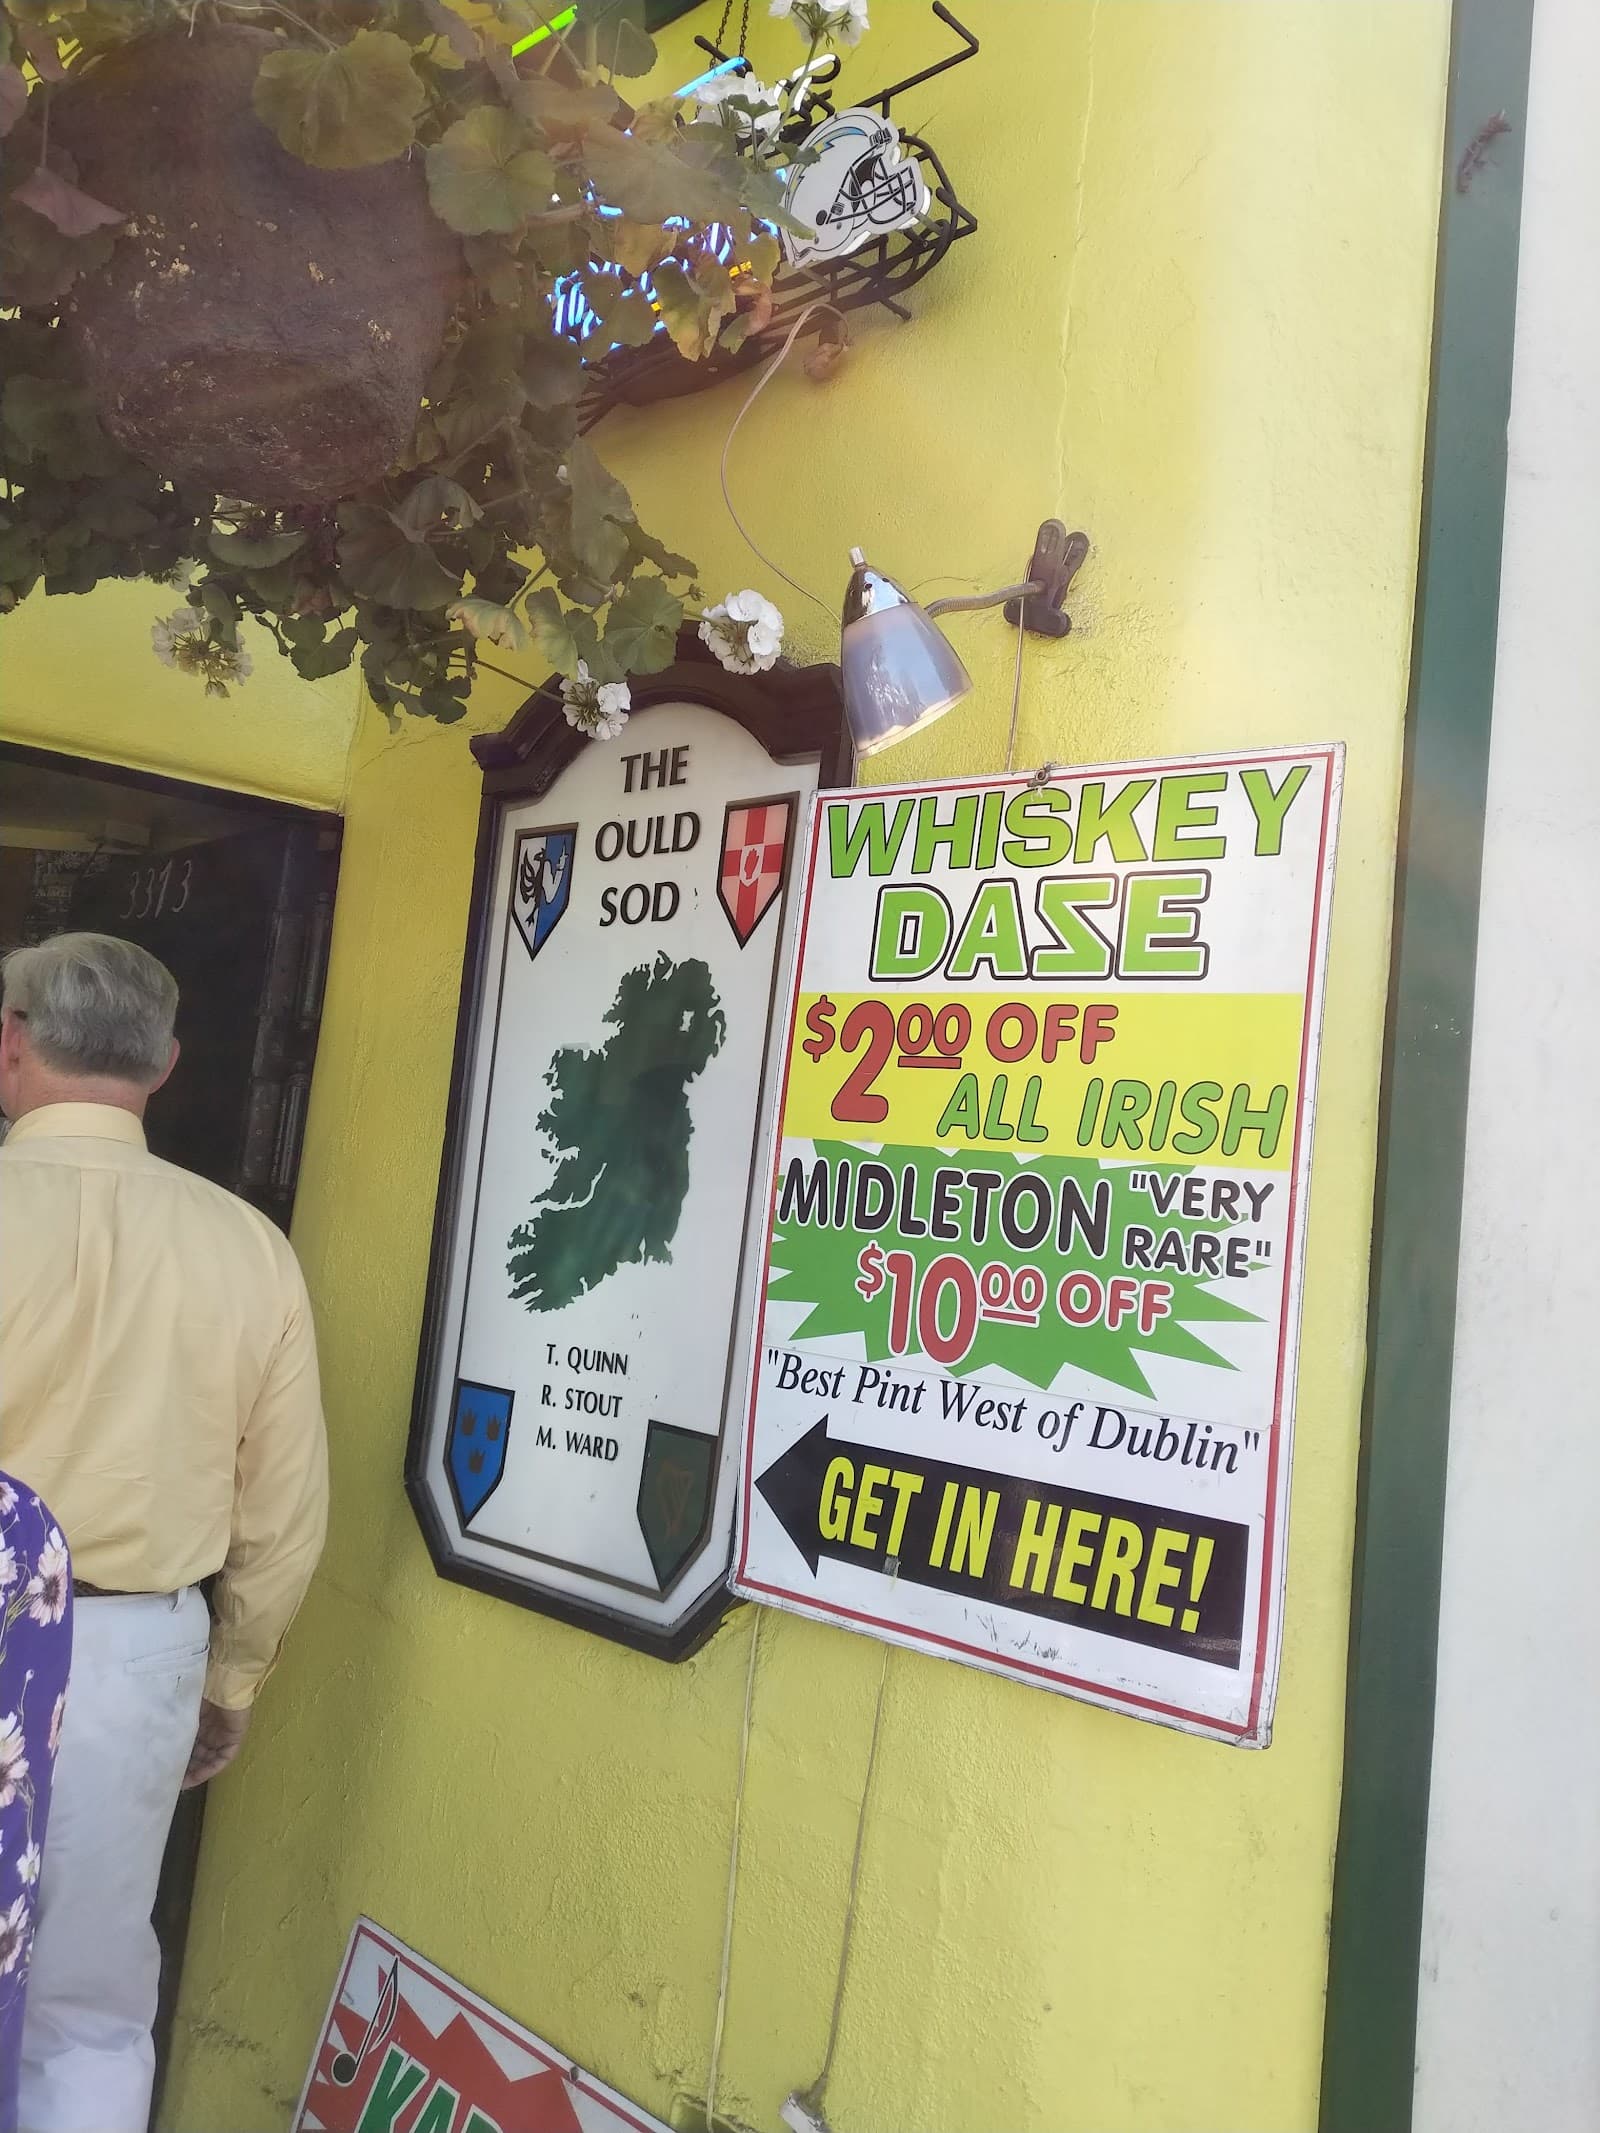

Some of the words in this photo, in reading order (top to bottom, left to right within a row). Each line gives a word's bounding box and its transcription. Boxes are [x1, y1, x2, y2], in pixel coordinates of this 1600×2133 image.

[620, 744, 690, 793] THE
[595, 811, 700, 861] OULD
[828, 765, 1312, 878] WHISKEY
[599, 881, 680, 927] SOD
[985, 1002, 1120, 1065] OFF
[936, 1073, 1049, 1144] ALL
[1077, 1077, 1289, 1159] IRISH
[778, 1157, 1110, 1257] MIDLETON
[1057, 1273, 1172, 1334] OFF
[547, 1343, 559, 1366] T.
[567, 1346, 628, 1375] QUINN
[541, 1384, 556, 1407] R.
[565, 1388, 622, 1418] STOUT
[852, 1366, 926, 1414] Pint
[940, 1379, 1026, 1433] West
[1037, 1401, 1085, 1453] of
[536, 1425, 556, 1449] M.
[566, 1430, 619, 1461] WARD
[818, 1456, 925, 1557] GET
[928, 1481, 1001, 1579] IN
[1008, 1499, 1215, 1633] HERE!
